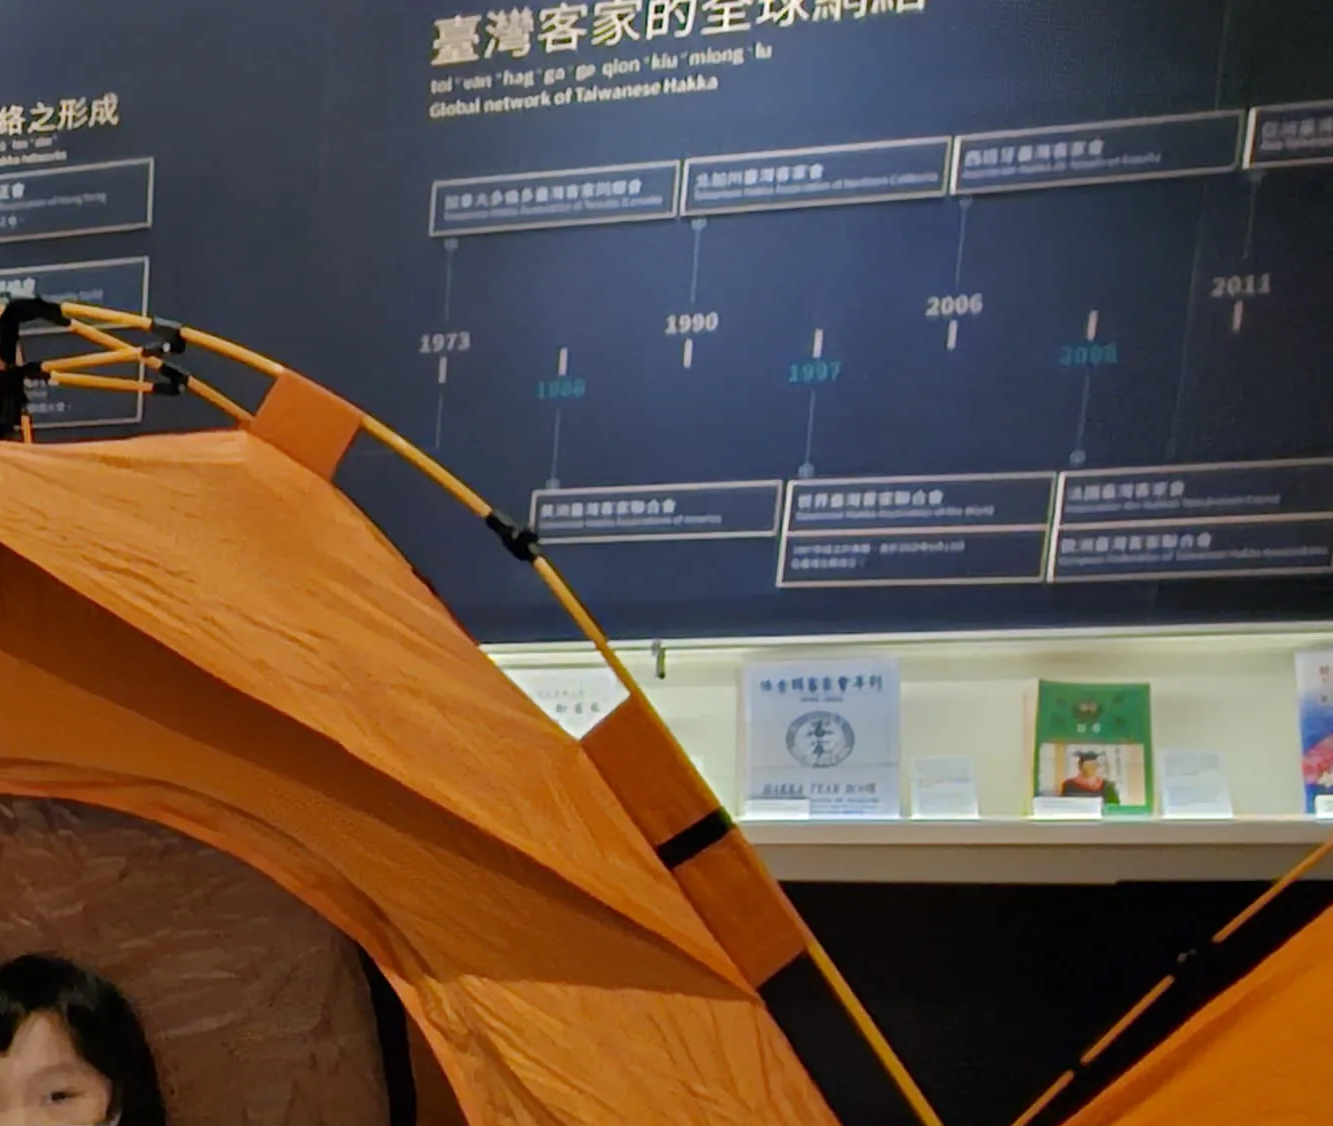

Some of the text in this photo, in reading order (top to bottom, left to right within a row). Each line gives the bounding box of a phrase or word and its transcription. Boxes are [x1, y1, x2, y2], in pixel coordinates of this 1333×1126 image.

[431, 0, 926, 66] 臺灣客家的全球
[429, 74, 719, 120] Global network of Taiwanese Hakka
[1210, 272, 1272, 299] 2011
[924, 293, 984, 318] 2006
[664, 311, 720, 336] 1990
[418, 331, 472, 354] 1973
